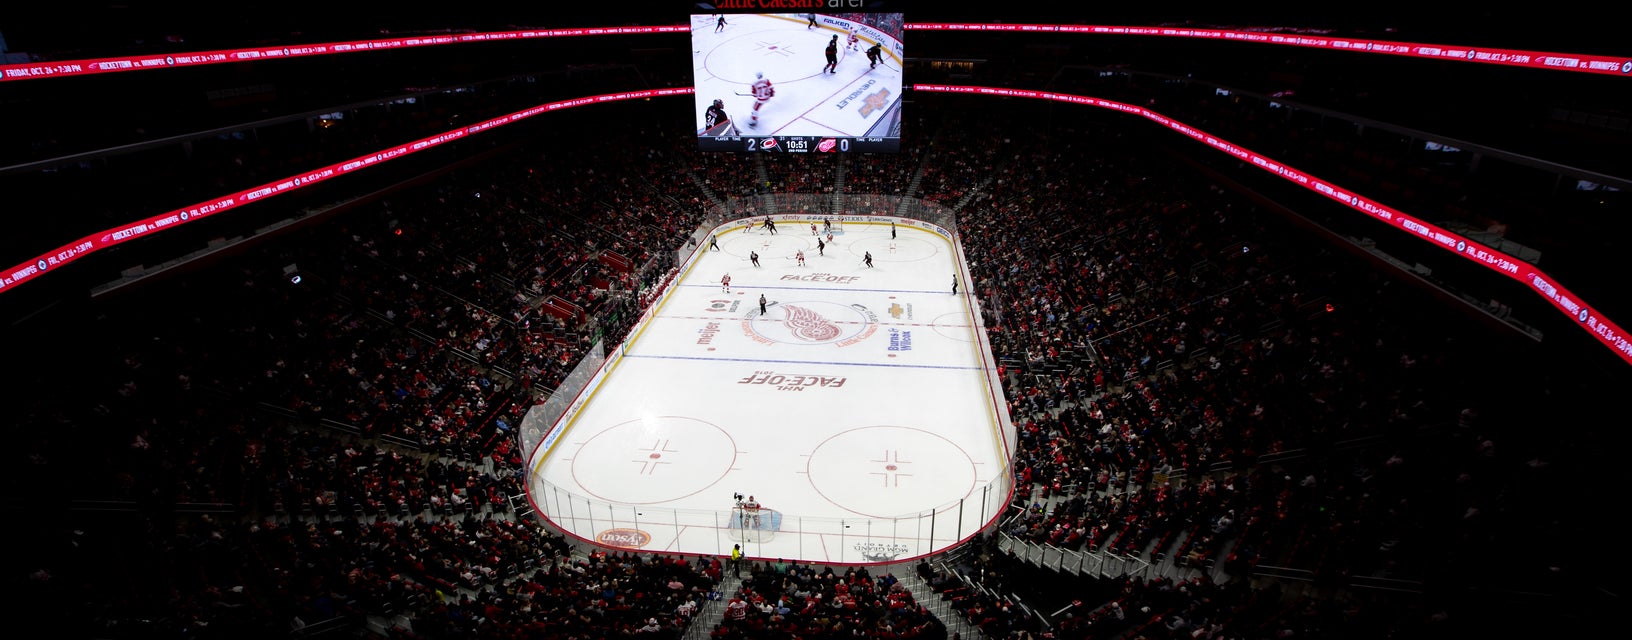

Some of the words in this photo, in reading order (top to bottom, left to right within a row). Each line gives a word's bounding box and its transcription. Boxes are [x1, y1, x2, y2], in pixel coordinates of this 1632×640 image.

[823, 18, 850, 28] FALKEN
[31, 67, 44, 76] OCT.
[44, 66, 53, 74] 26
[58, 65, 71, 73] 7:30
[71, 64, 82, 72] PM
[836, 79, 876, 110] CHEVROLET
[748, 138, 756, 151] 2
[786, 140, 808, 149] 10:51
[840, 138, 849, 151] 0
[937, 227, 950, 238] GEICO
[1508, 263, 1519, 274] PM
[696, 322, 720, 344] meijer
[888, 333, 899, 351] Burns
[900, 331, 912, 351] Wilcox
[737, 374, 848, 387] FACE-OFF
[601, 532, 642, 545] Tyson
